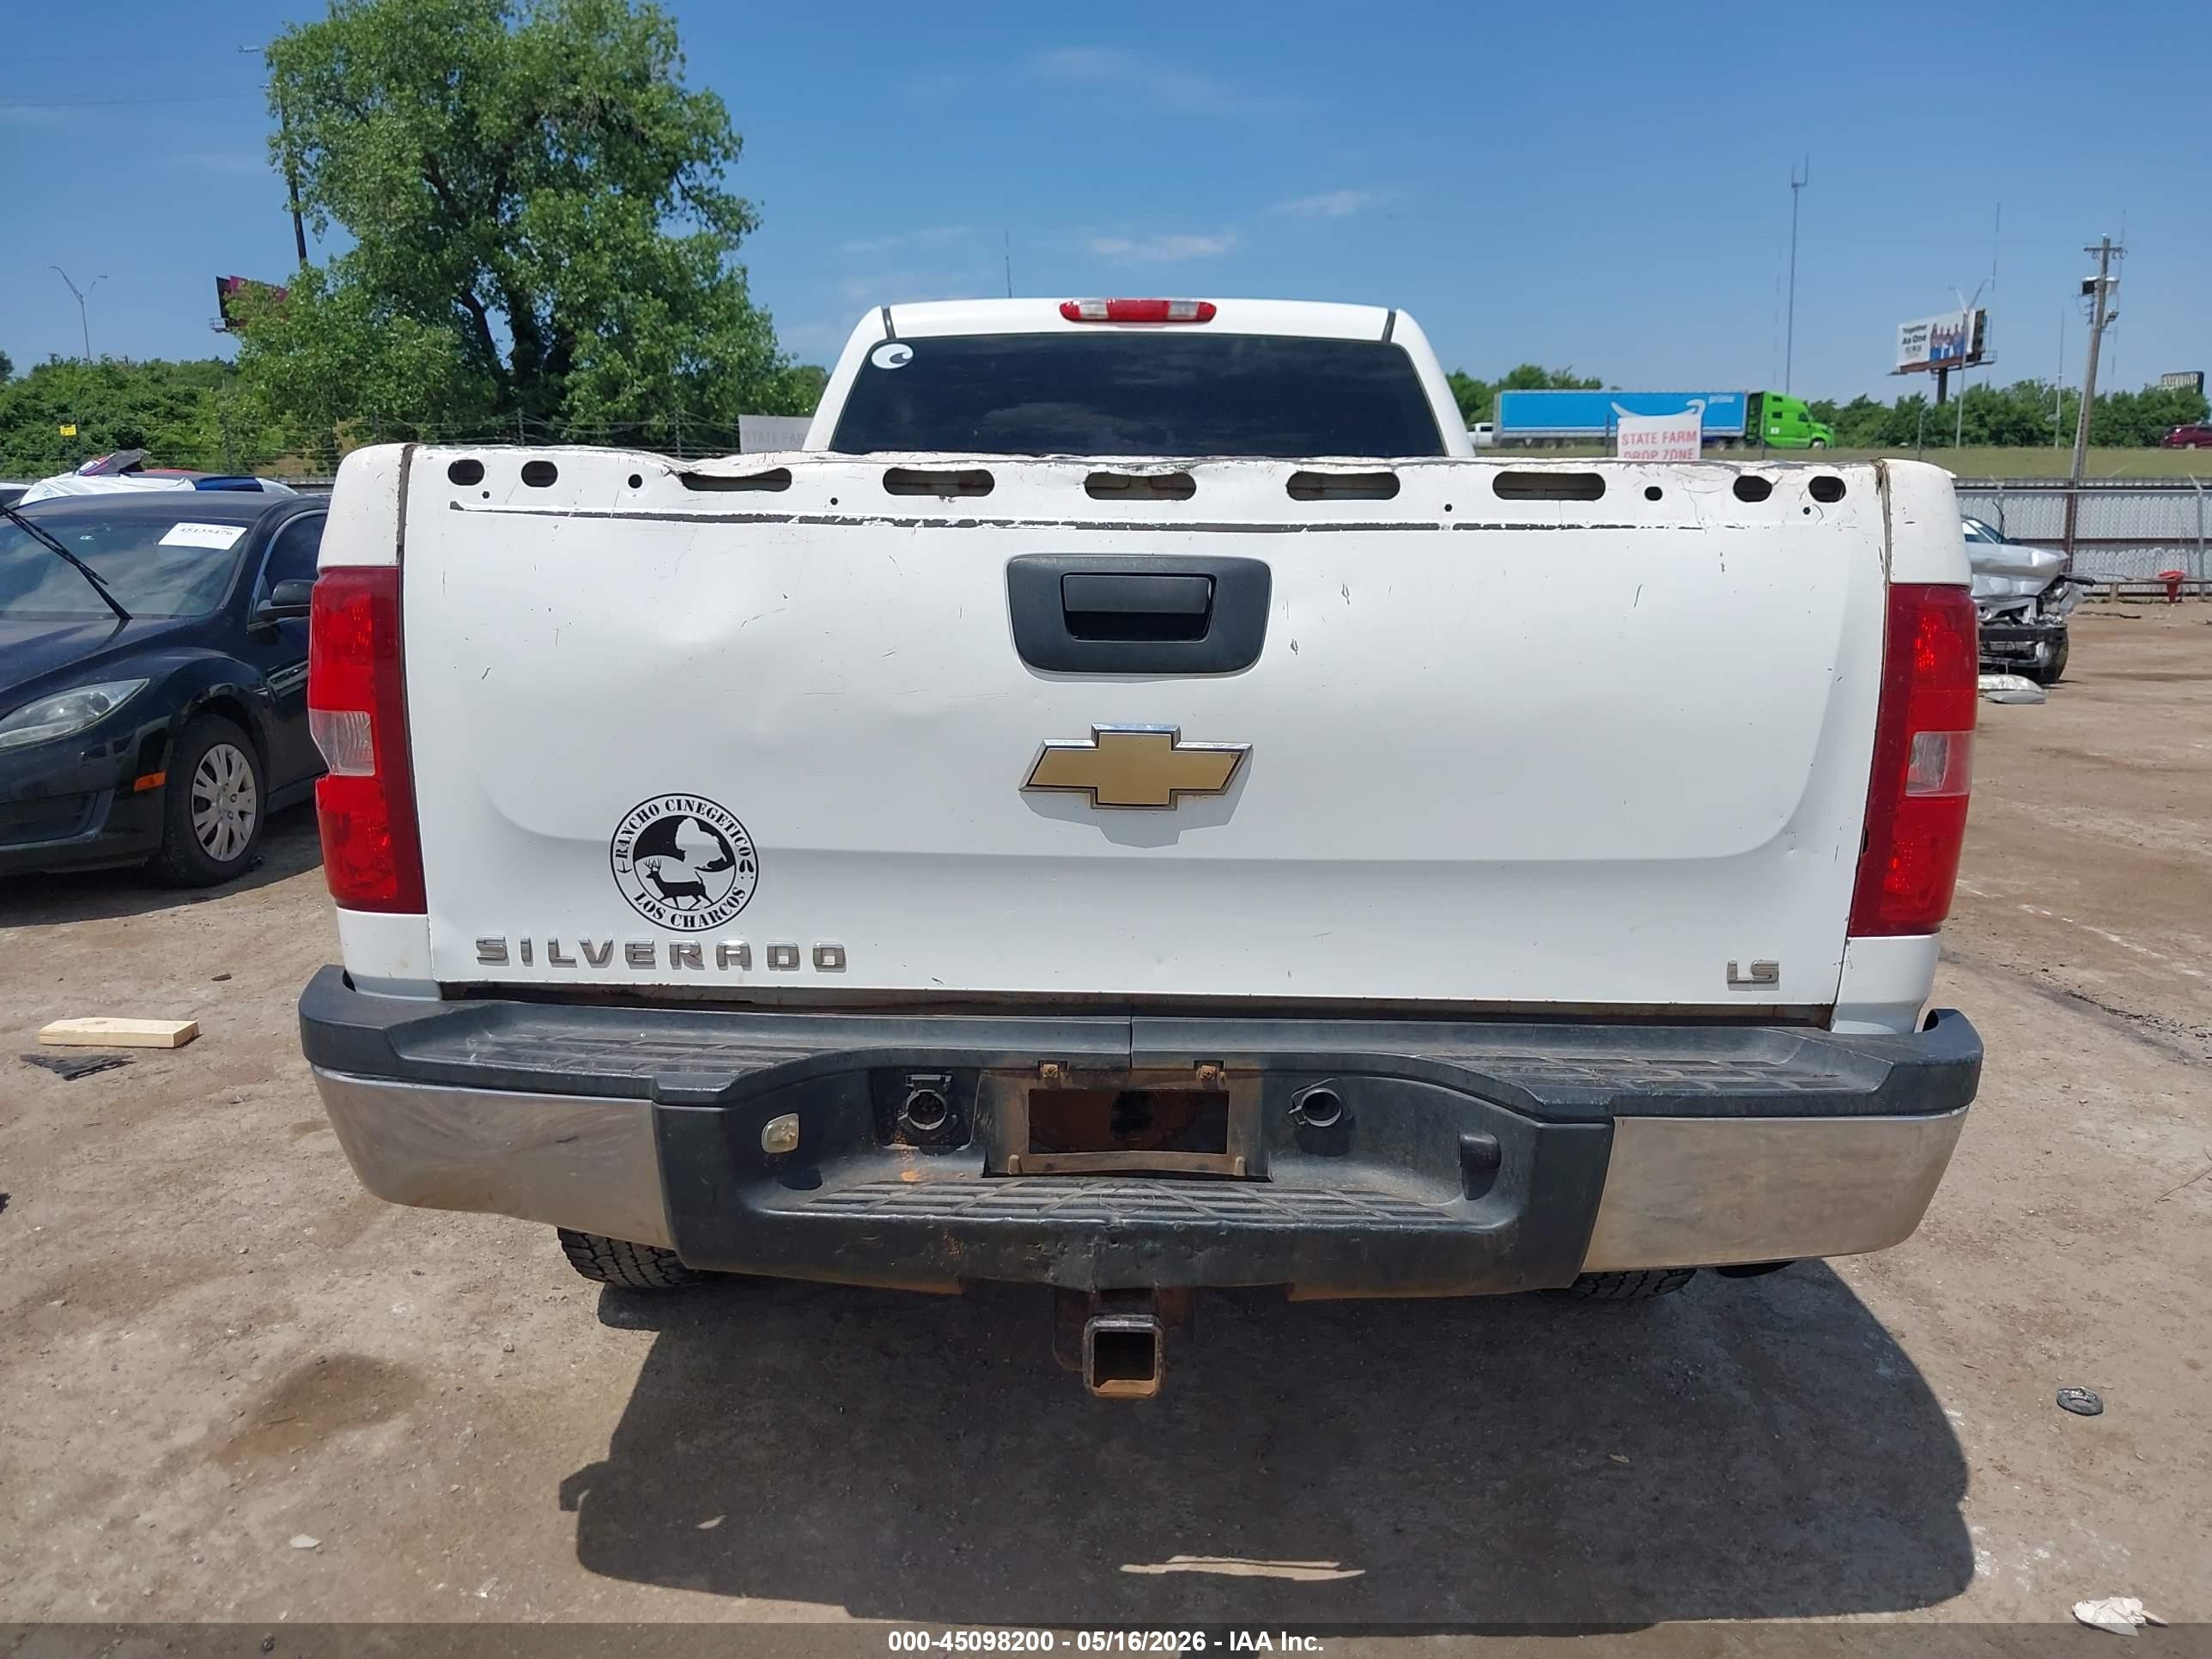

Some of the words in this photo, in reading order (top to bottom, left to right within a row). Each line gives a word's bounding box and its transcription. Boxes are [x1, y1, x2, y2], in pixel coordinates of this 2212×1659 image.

[743, 431, 778, 444] STATE
[782, 432, 806, 445] FAR
[1621, 431, 1659, 446] STATE
[1662, 430, 1698, 444] FARM
[1662, 447, 1695, 460] ZONE
[615, 803, 660, 860] RANCHO
[665, 799, 751, 857] CINEGETICO
[634, 891, 666, 921] LOS
[670, 886, 746, 928] CHARCOS
[476, 935, 846, 971] SILVERADO
[1727, 959, 1780, 985] LS
